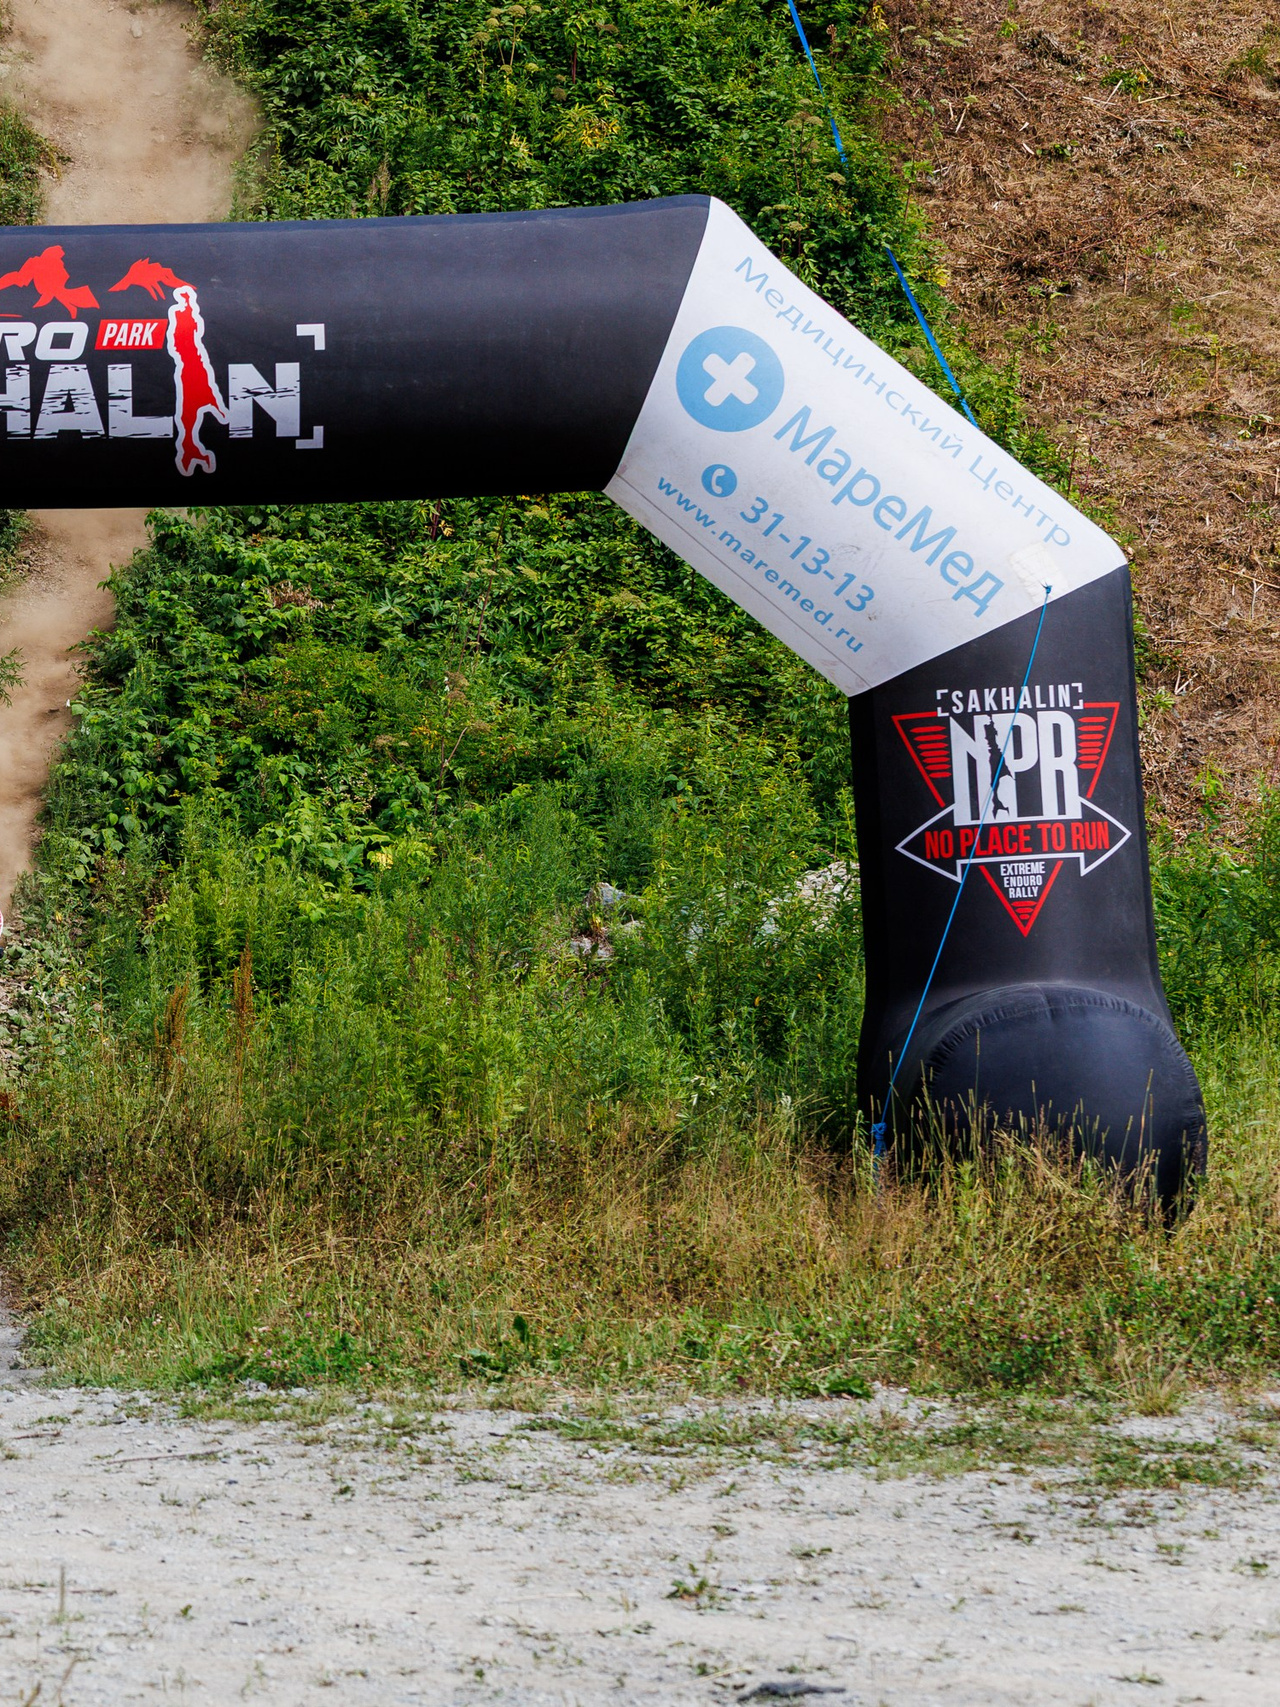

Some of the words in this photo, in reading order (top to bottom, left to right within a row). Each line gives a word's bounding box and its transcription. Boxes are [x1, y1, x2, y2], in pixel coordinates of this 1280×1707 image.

[102, 322, 157, 348] PARK
[734, 256, 964, 459] Медицинский
[969, 455, 1071, 548] Центр
[774, 405, 1005, 618] МареМед
[657, 476, 864, 654] www.maremed.ru
[740, 496, 876, 613] 31-13-13
[951, 684, 1071, 714] SAKHALIN
[949, 711, 1083, 827] NPR
[925, 829, 954, 859] NO
[960, 824, 1033, 857] PLACE
[1037, 822, 1066, 852] TO
[1071, 821, 1110, 850] RUN
[1000, 861, 1046, 876] EXTREME
[1003, 874, 1043, 888] ENDURO
[1008, 886, 1039, 899] RALLY
